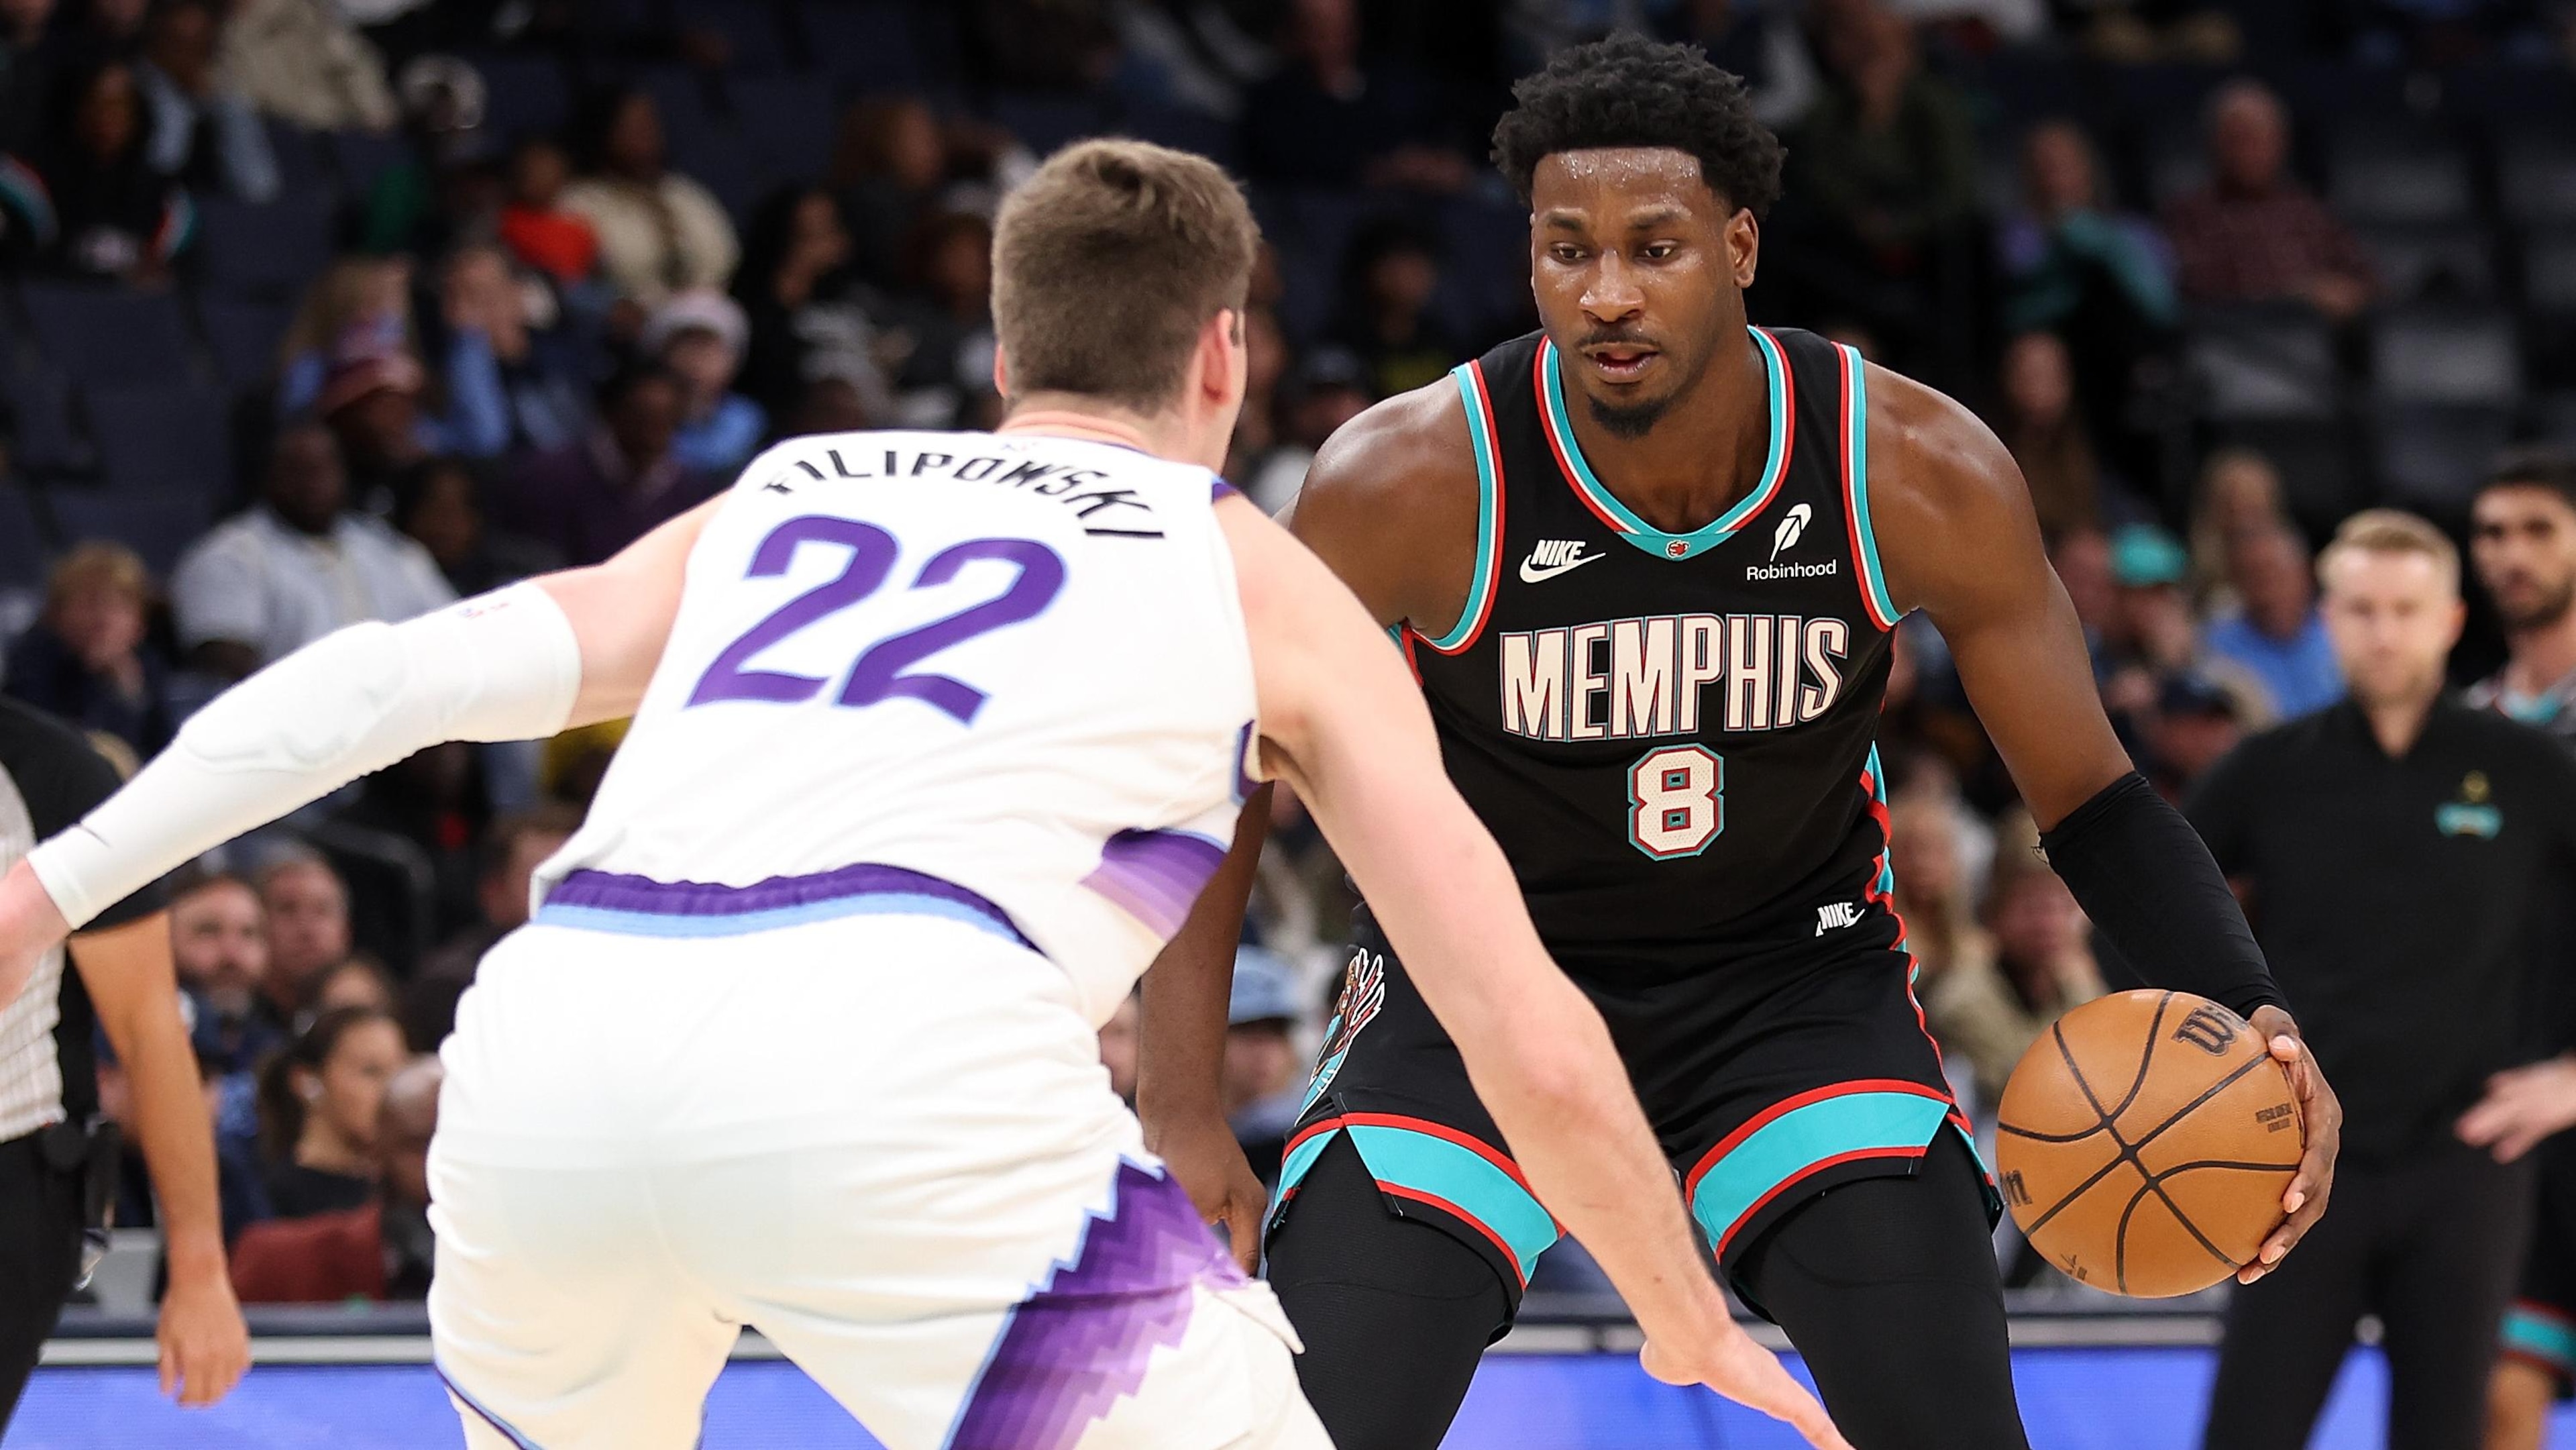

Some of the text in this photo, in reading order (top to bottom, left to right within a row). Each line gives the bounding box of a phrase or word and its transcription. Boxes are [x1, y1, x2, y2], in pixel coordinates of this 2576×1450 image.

[763, 449, 1165, 539] FILIPOWSKI
[1530, 539, 1586, 566] NIKE
[1746, 558, 1837, 581] Robinhood
[683, 513, 1068, 729] 22
[1499, 613, 1849, 742] MEMPHIS
[1627, 743, 1724, 861] 8
[1817, 902, 1854, 929] NIKE
